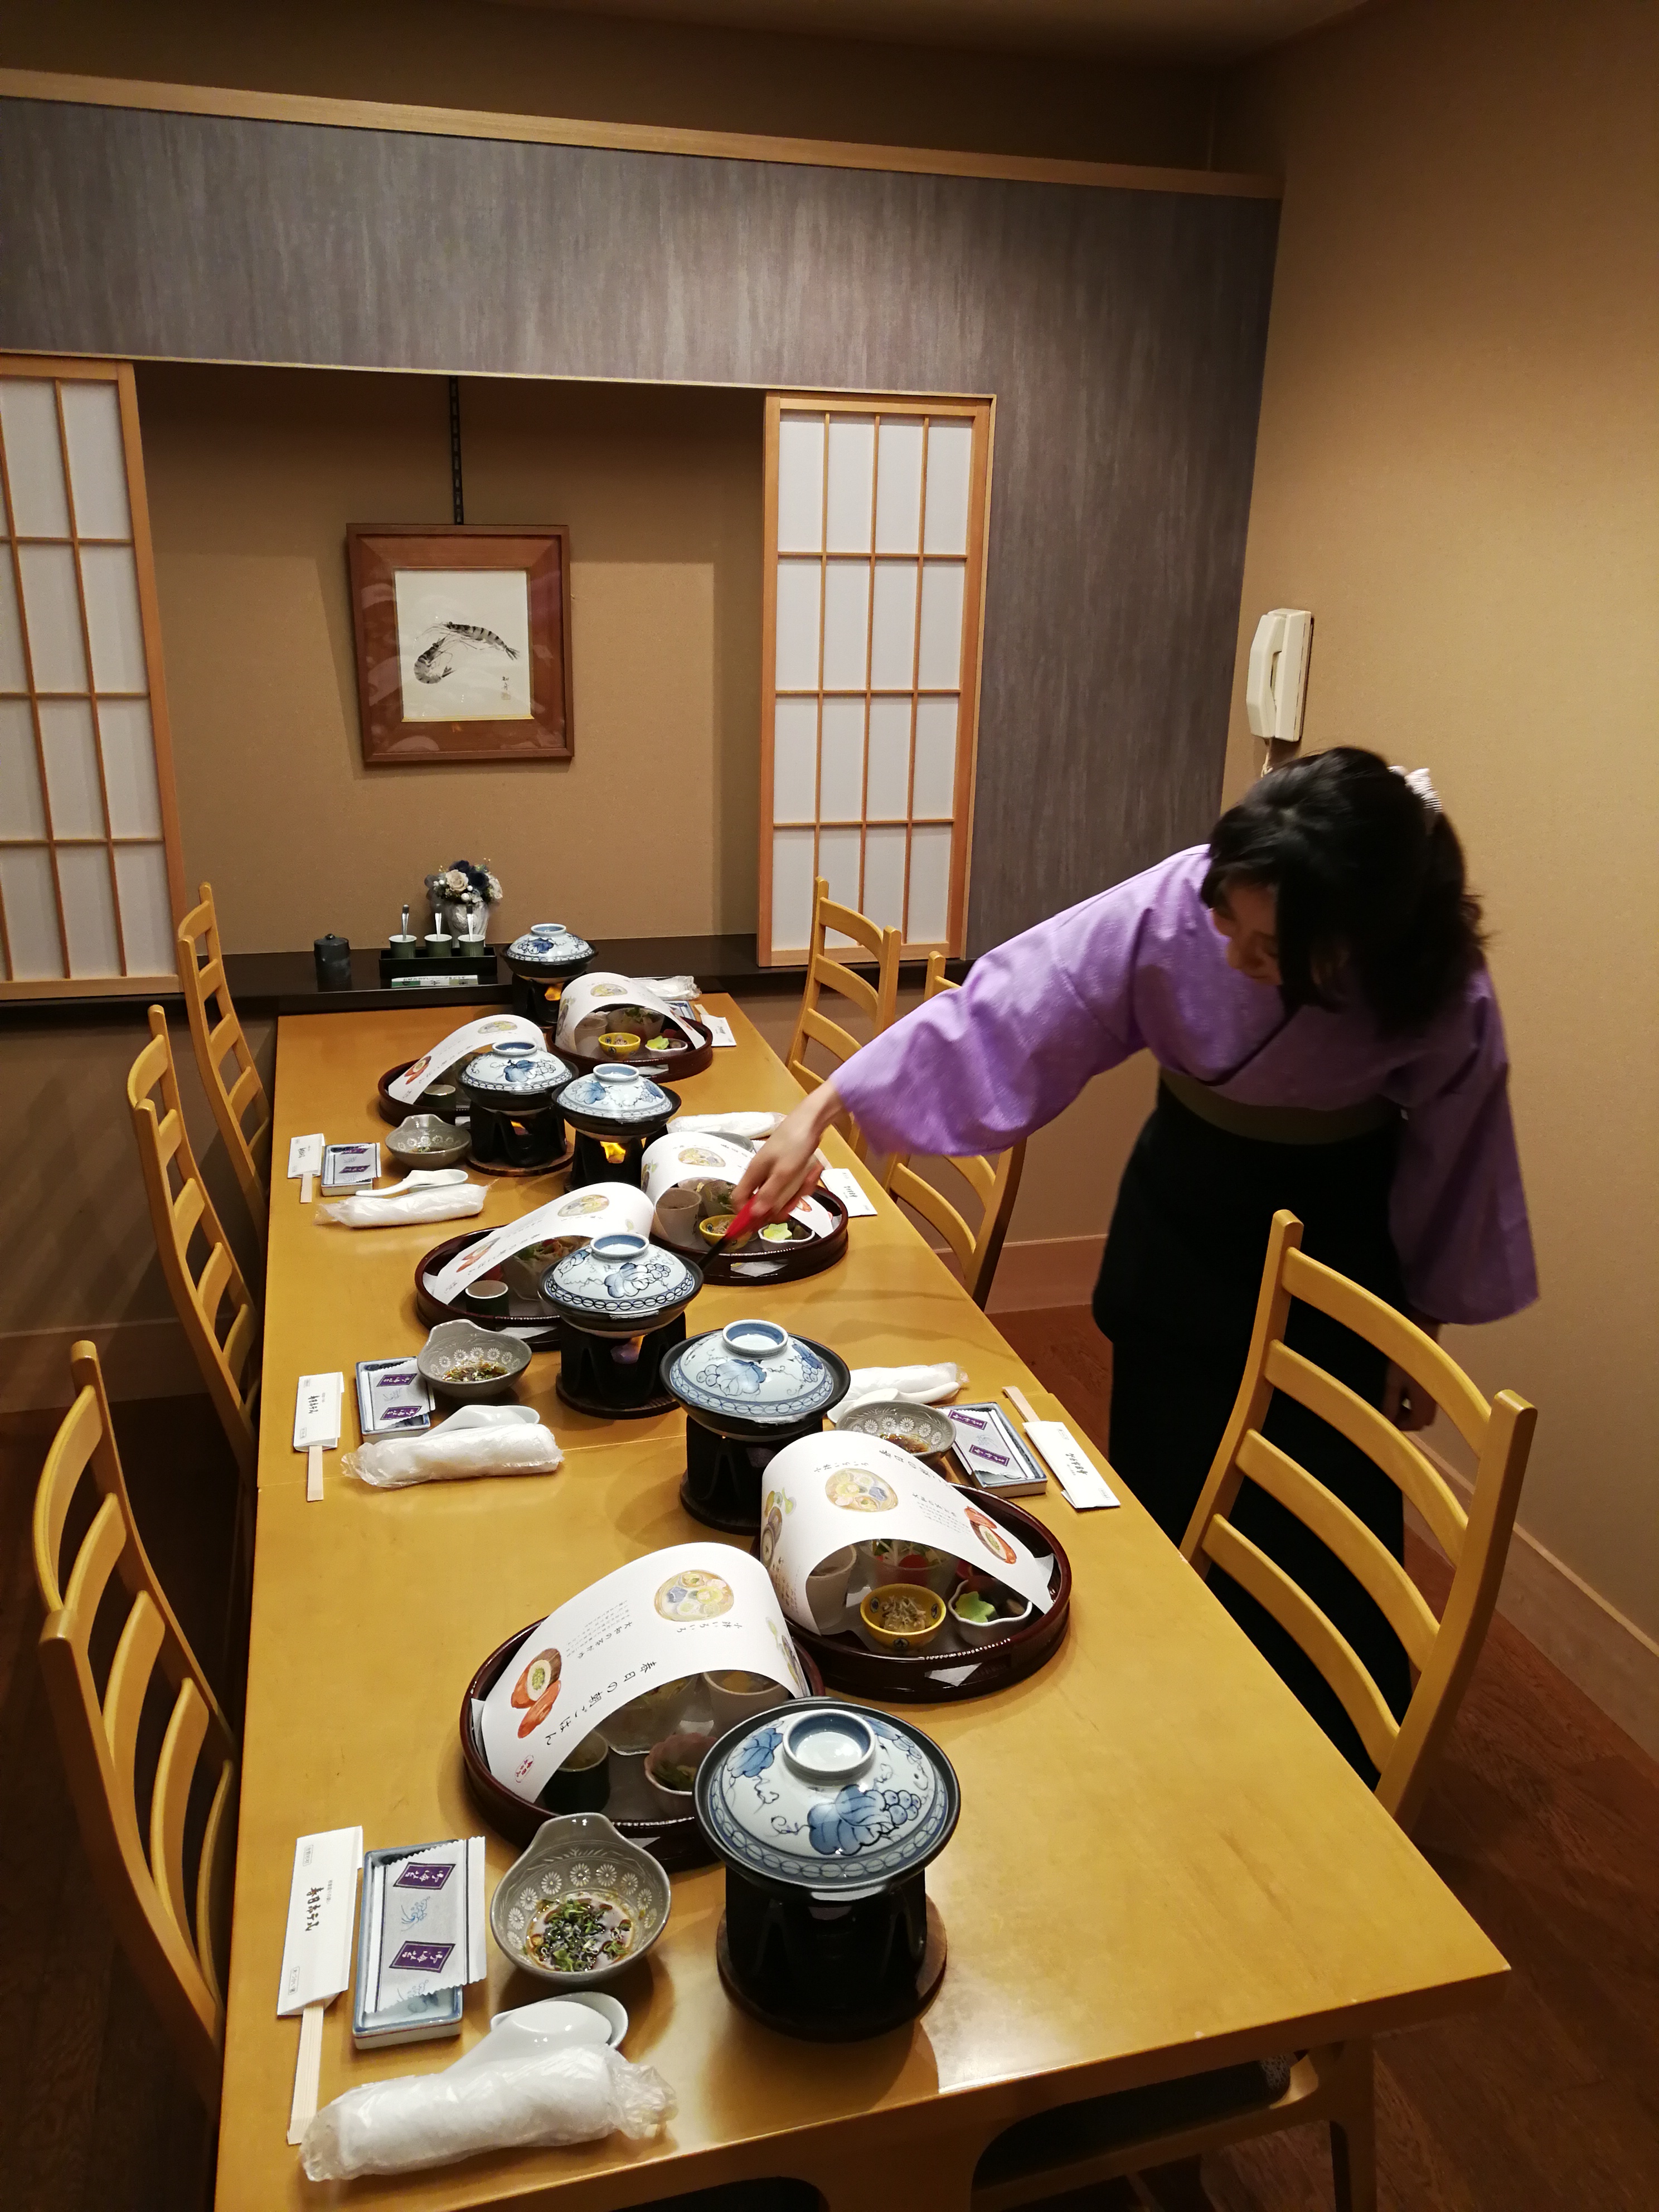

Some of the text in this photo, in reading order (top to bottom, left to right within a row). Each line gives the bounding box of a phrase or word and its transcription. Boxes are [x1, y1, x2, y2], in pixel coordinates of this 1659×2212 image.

[578, 1621, 633, 1660] 大和の茶がゆ
[676, 1620, 743, 1634] 小鉢いろいろ
[544, 1660, 657, 1747] 春日の朝ごはん
[305, 1886, 324, 1932] 春日ホテル
